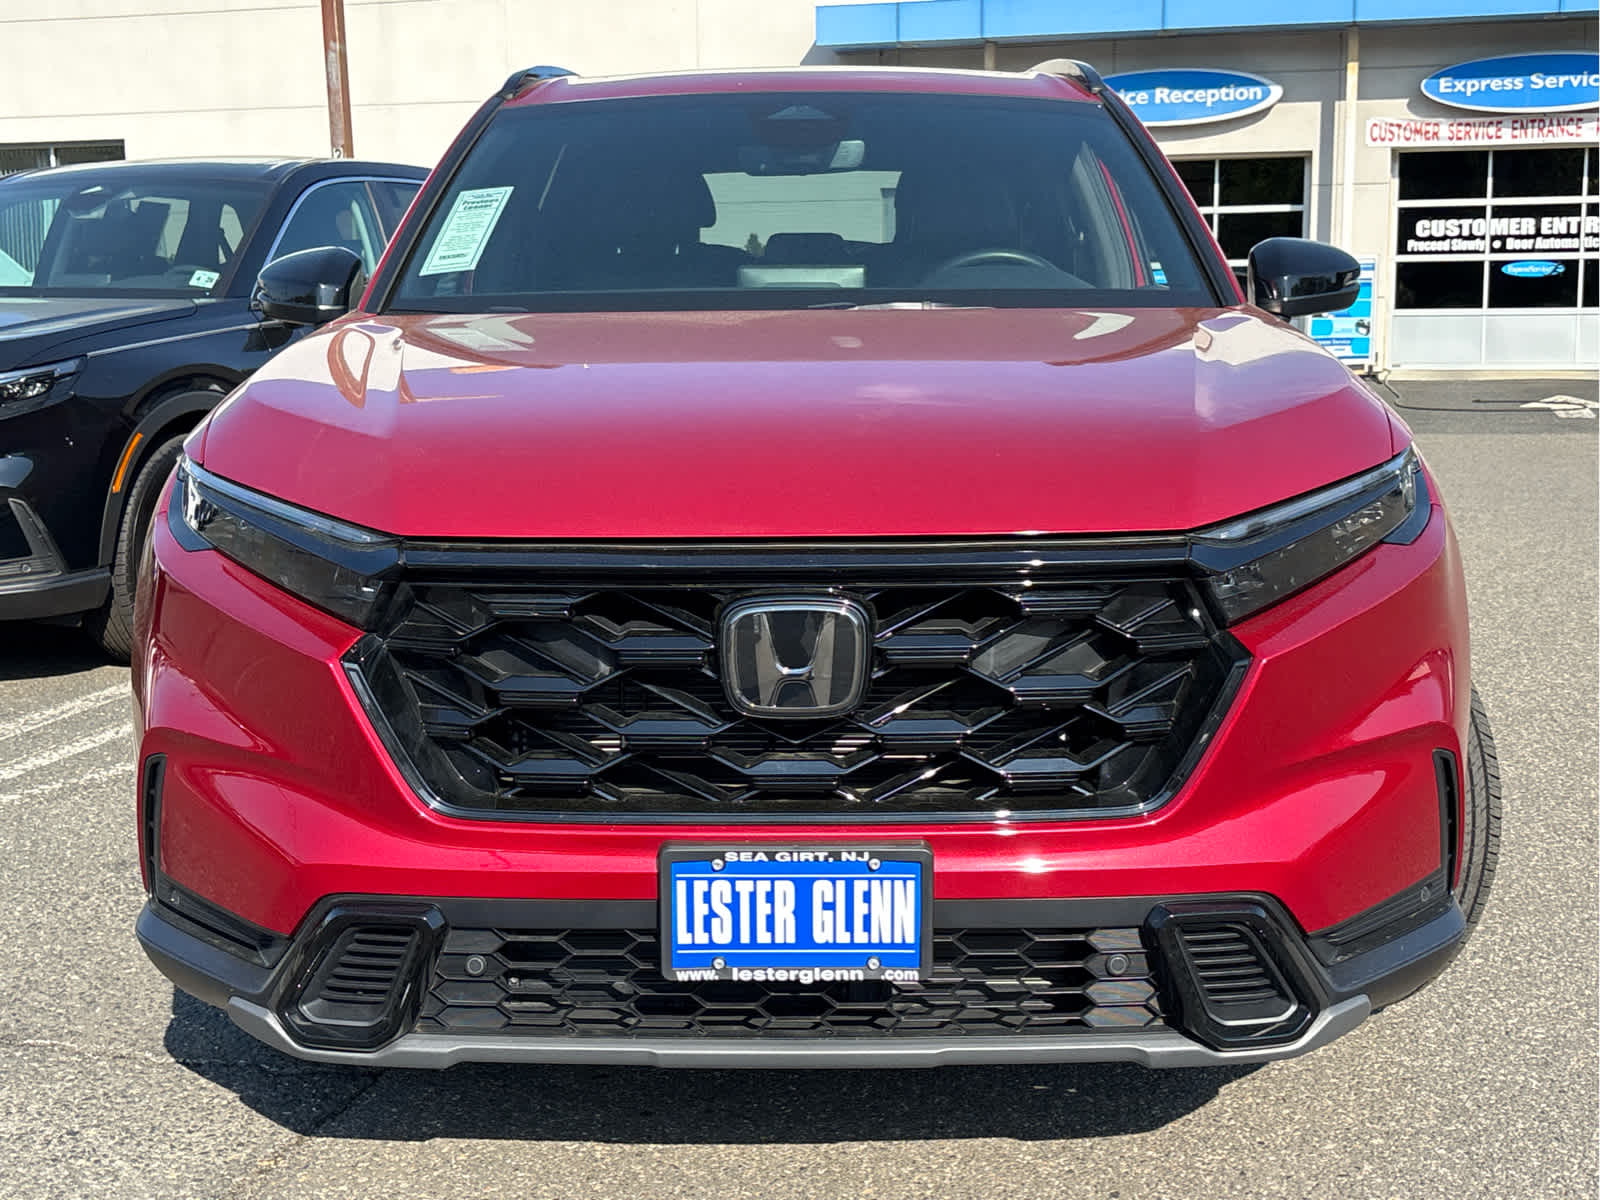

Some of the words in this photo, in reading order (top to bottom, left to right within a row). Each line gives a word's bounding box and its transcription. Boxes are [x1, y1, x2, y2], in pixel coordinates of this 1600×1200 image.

[1154, 84, 1263, 107] Reception
[1439, 77, 1524, 96] Express
[1370, 122, 1440, 142] CUSTOMER
[1447, 120, 1502, 141] SERVICE
[1511, 117, 1584, 138] ENTRANCE
[1415, 217, 1536, 238] CUSTOMER
[1407, 240, 1450, 252] Proceed
[1451, 239, 1486, 252] Slowly
[1505, 237, 1534, 250] Door
[724, 850, 769, 863] SEA
[775, 850, 834, 864] GIRT,
[841, 850, 870, 862] NJ
[676, 879, 796, 945] LESTER
[812, 879, 916, 945] GLENN
[676, 970, 719, 981] www.
[732, 967, 864, 984] lesterglenn
[880, 968, 919, 981] .com
